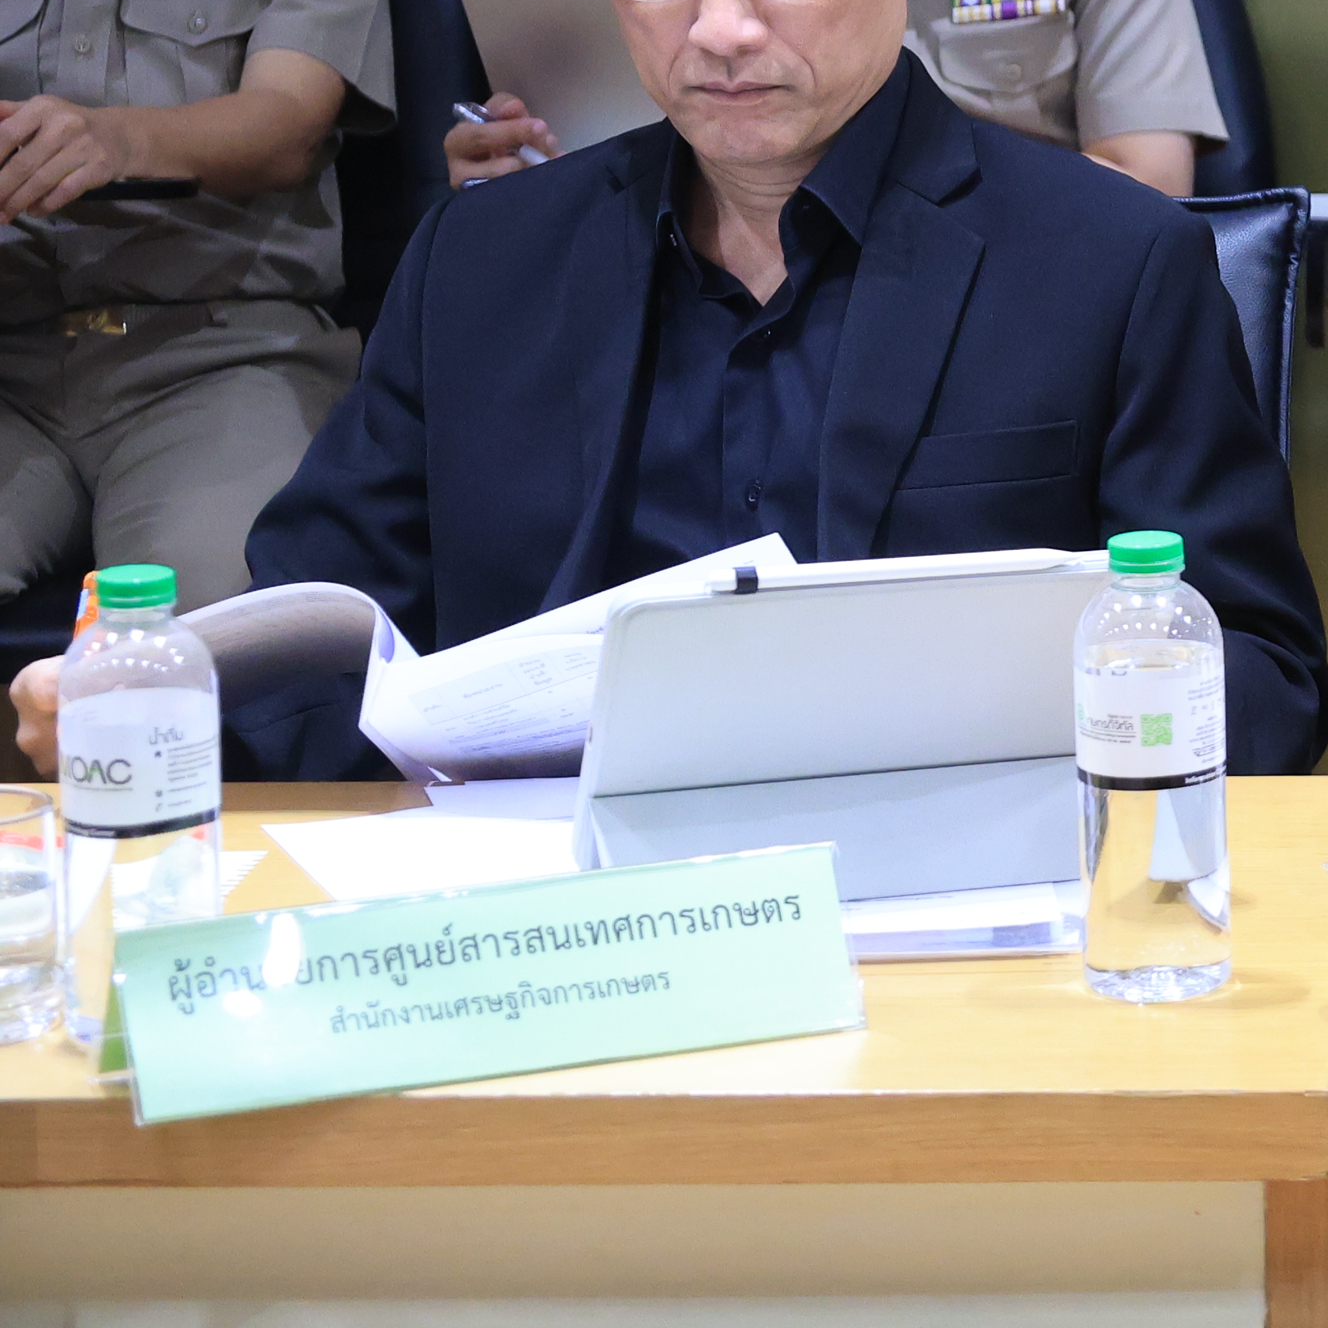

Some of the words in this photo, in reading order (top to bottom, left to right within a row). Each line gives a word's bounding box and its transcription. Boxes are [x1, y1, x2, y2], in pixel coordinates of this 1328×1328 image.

[168, 894, 802, 1015] ผู้อำนยการศูนย์สารสนเทศการเกษตร
[330, 971, 671, 1034] สำนักงานเศรษฐกิจการเกษตร
